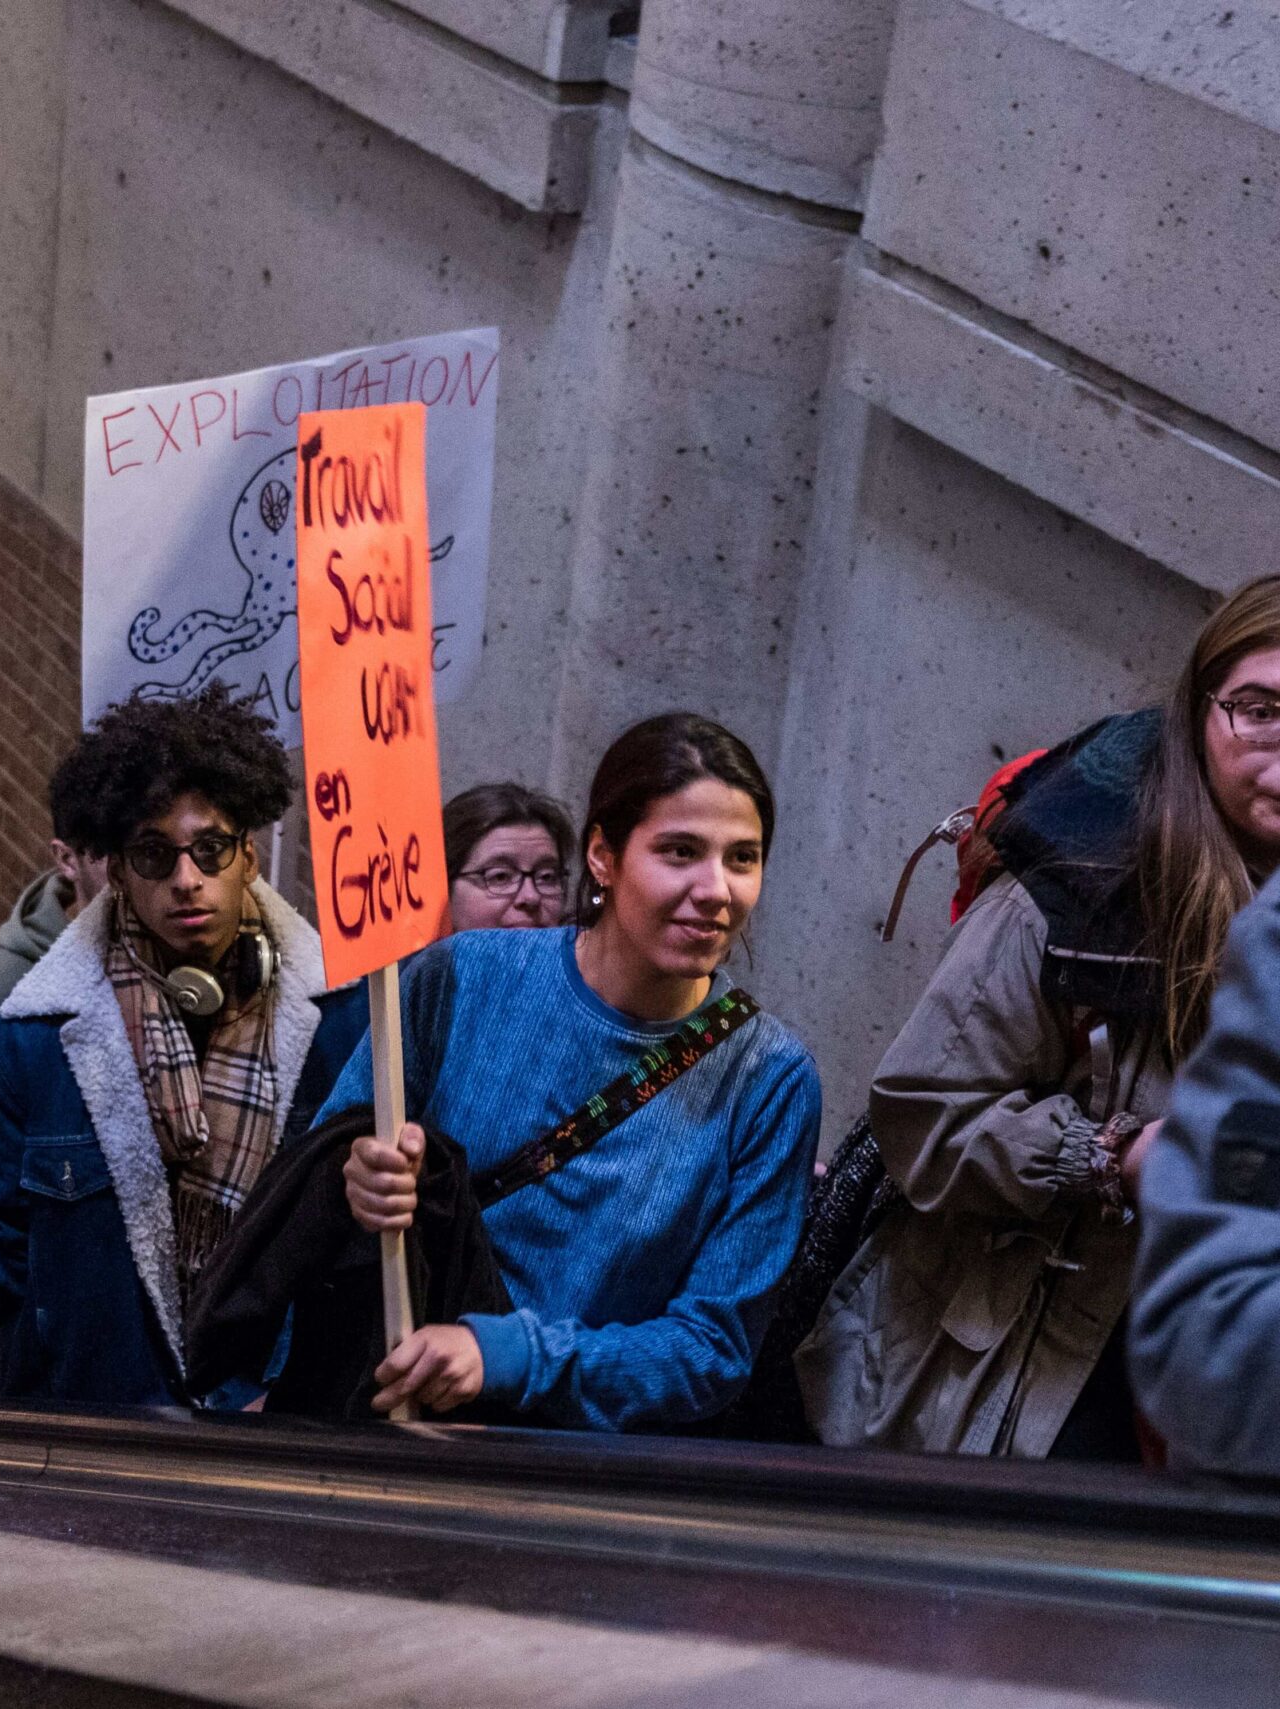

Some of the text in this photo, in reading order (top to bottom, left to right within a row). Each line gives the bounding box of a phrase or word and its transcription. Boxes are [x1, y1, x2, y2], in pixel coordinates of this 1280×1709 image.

[102, 351, 498, 477] EXPLOITATION
[301, 413, 405, 533] Travail
[314, 768, 352, 823] en
[331, 819, 424, 941] Grève
